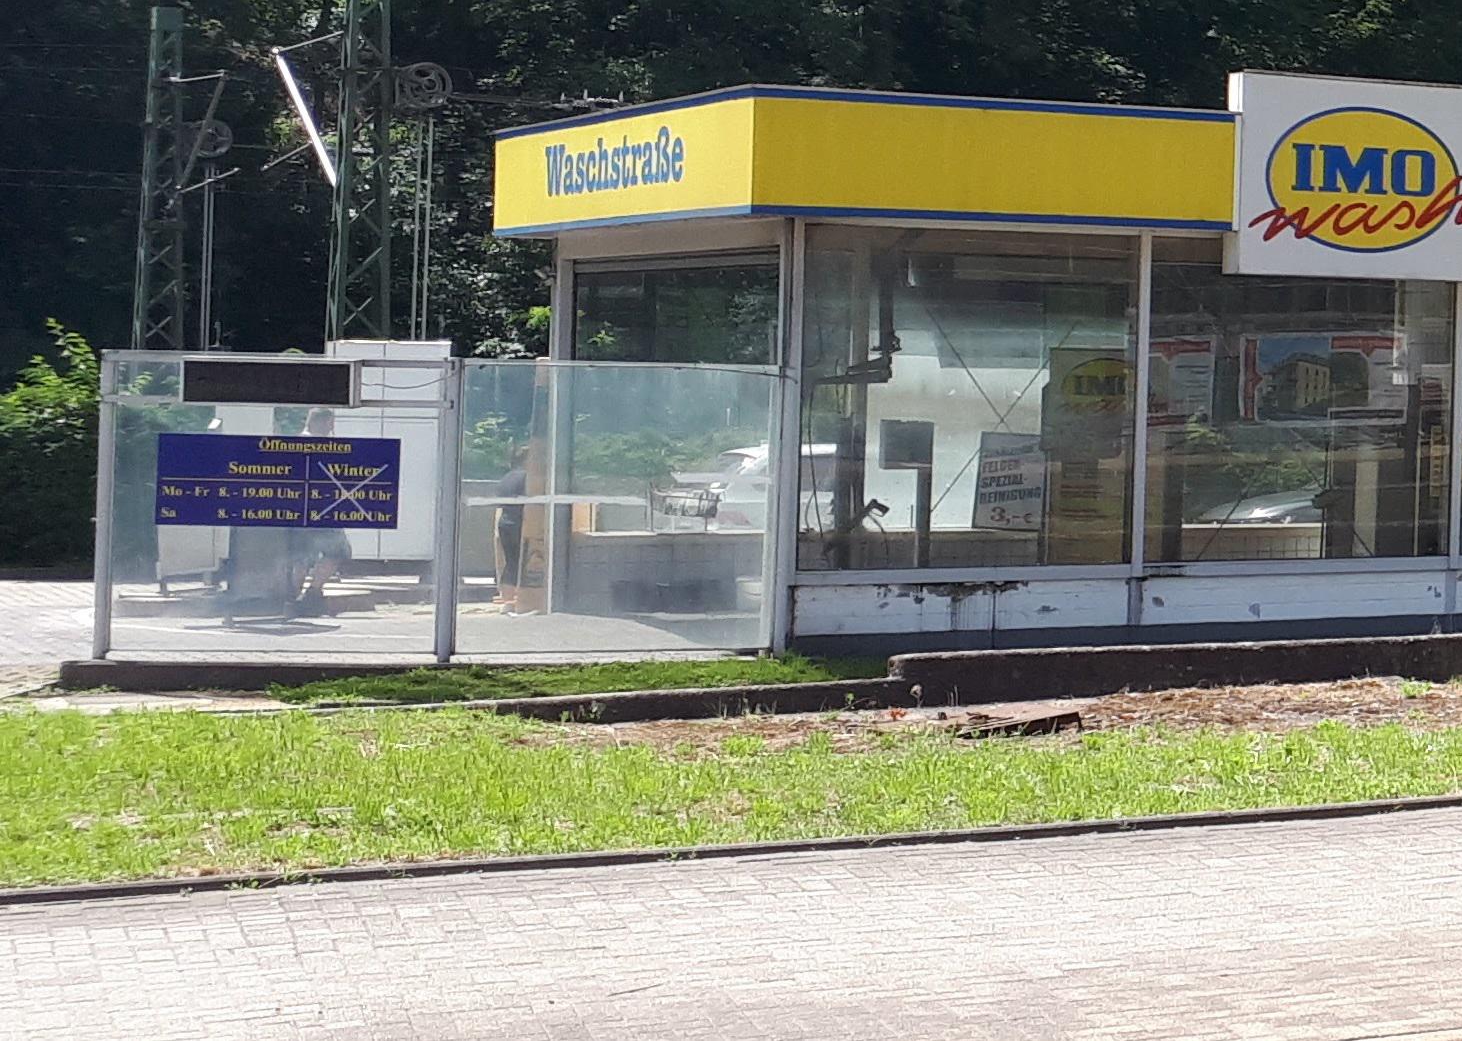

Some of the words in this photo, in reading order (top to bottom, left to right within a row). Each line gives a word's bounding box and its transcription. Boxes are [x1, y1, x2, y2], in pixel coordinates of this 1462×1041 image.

[545, 126, 684, 197] Waschstraße
[1291, 143, 1436, 197] IMO
[258, 437, 352, 452] Öffnungszeiten
[228, 461, 293, 475] Sommer
[327, 463, 381, 477] Winter
[162, 485, 183, 496] Mo
[195, 486, 210, 497] Fr
[242, 487, 274, 498] 19.00
[277, 488, 302, 499] Uhr
[368, 490, 392, 501] Uhr
[161, 506, 177, 518] Sa
[241, 509, 273, 520] 16.00
[275, 509, 301, 520] Uhr
